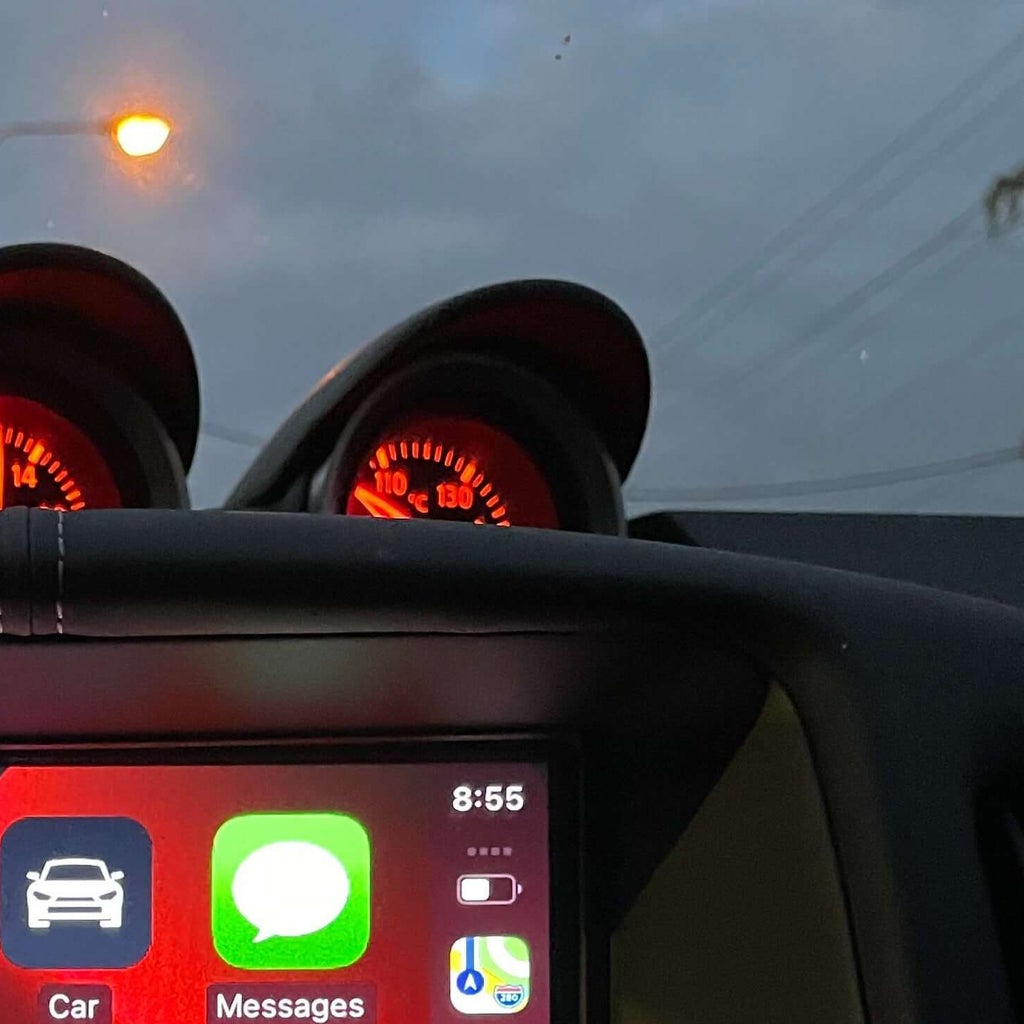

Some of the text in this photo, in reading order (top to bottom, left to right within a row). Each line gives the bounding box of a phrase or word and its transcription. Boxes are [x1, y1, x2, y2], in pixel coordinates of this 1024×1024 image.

[12, 464, 37, 488] 14
[375, 471, 408, 495] 110
[437, 484, 474, 509] 130
[452, 784, 525, 812] 8:55
[48, 993, 100, 1019] Car
[216, 993, 365, 1023] Messages
